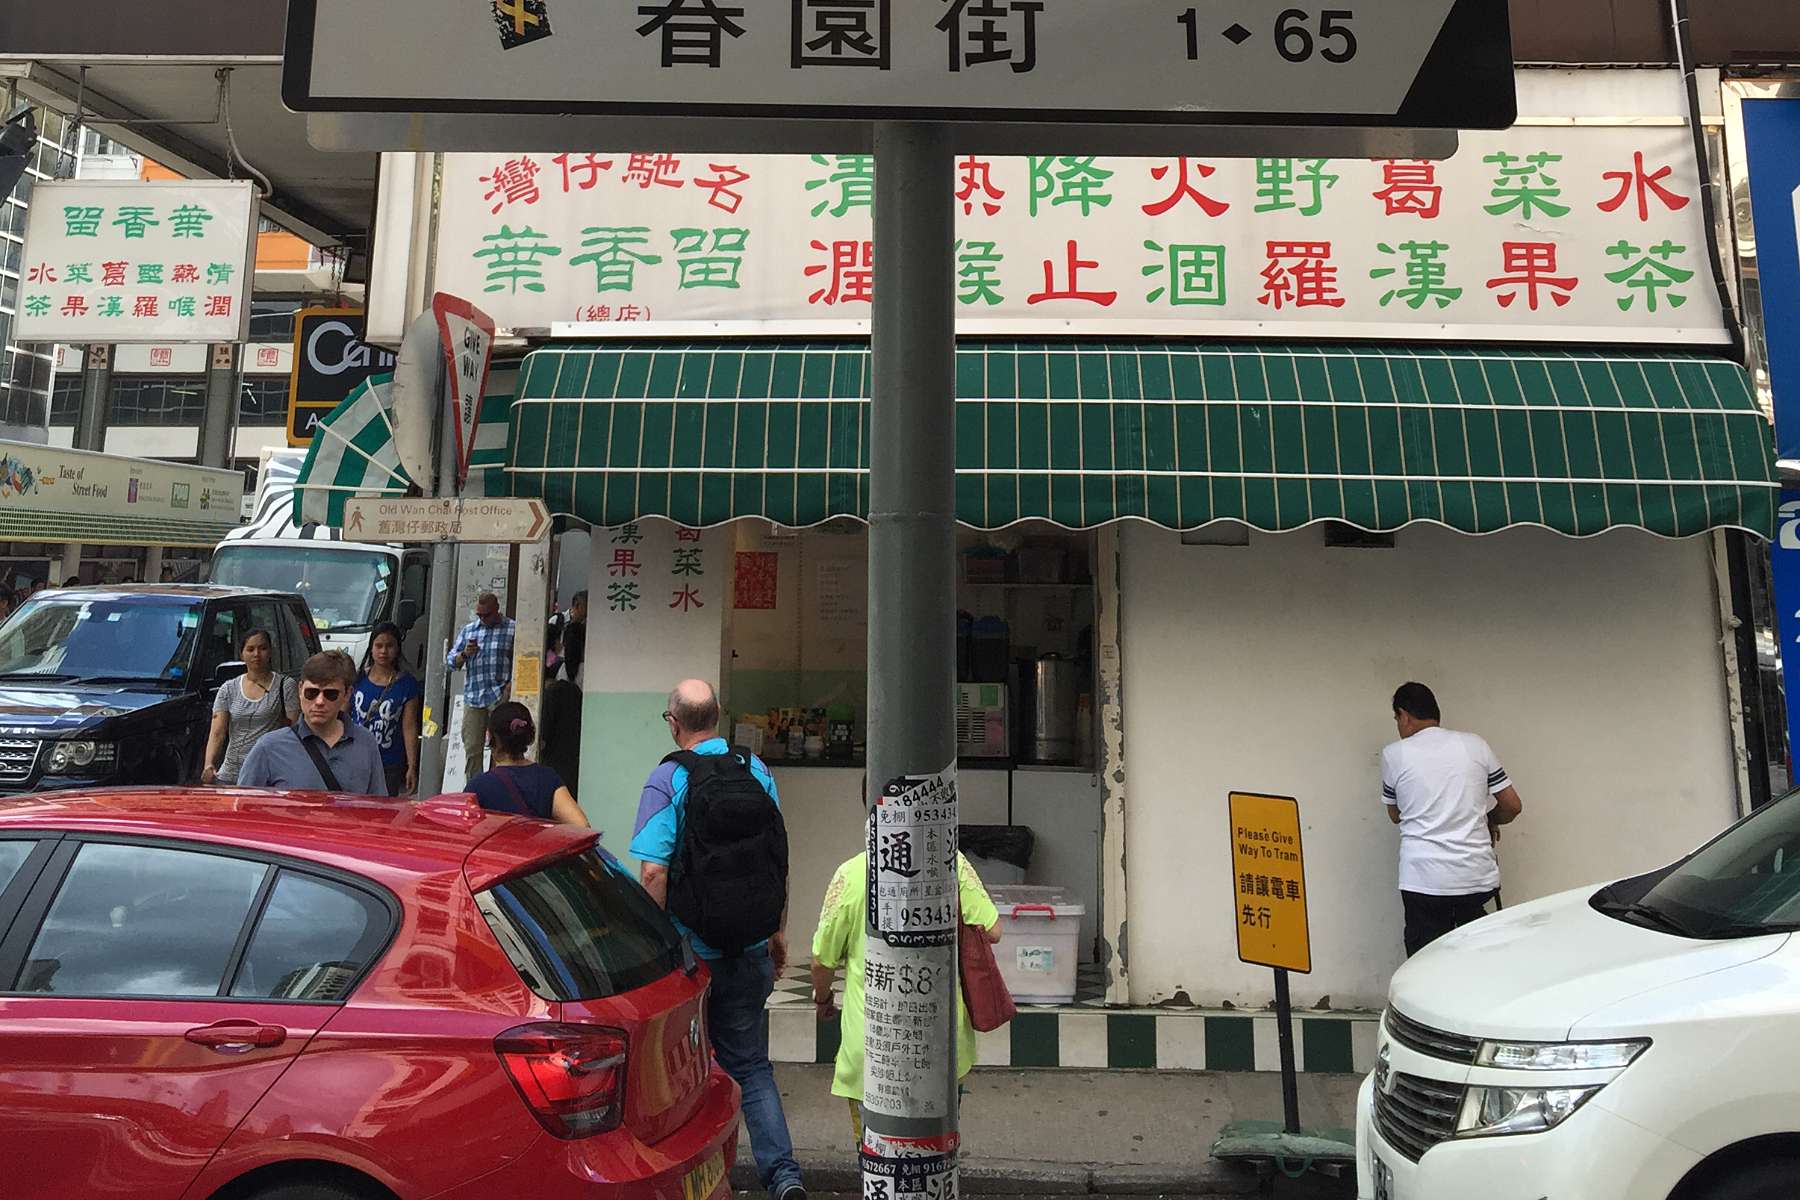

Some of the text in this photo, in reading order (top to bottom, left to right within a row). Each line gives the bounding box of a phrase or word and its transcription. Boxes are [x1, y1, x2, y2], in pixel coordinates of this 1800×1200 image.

[479, 153, 751, 215] 灣仔馳名
[472, 224, 751, 295] 葉香留
[464, 326, 481, 356] GIVE
[463, 355, 479, 383] WAY
[58, 465, 85, 481] Taste of
[72, 483, 108, 499] Street Food
[379, 505, 397, 516] Old
[400, 505, 425, 516] Wan
[480, 506, 513, 517] Office
[1238, 827, 1293, 845] Please Give
[880, 831, 921, 878] 通
[1239, 844, 1298, 862] Way To Tram
[1240, 873, 1300, 901] 請讓電車
[1243, 904, 1271, 929] 先行
